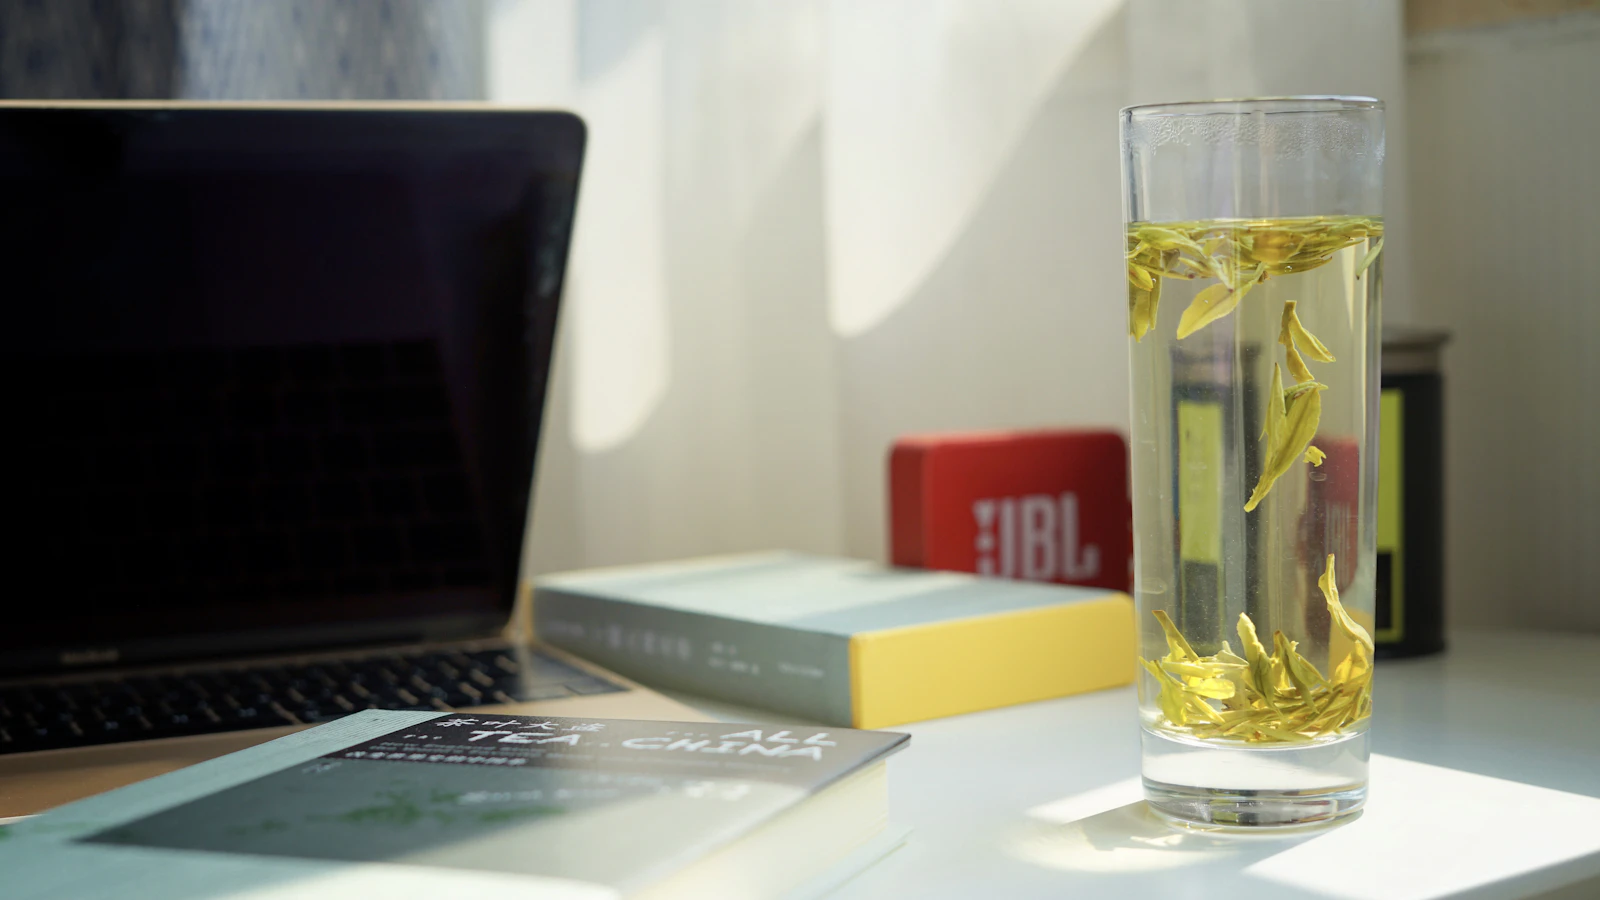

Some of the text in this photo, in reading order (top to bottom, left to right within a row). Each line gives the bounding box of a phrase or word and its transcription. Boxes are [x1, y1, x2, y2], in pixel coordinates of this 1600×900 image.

[972, 490, 1100, 580] JBL
[468, 730, 581, 746] TEA
[621, 737, 822, 761] CHINA
[719, 729, 837, 747] ALL
